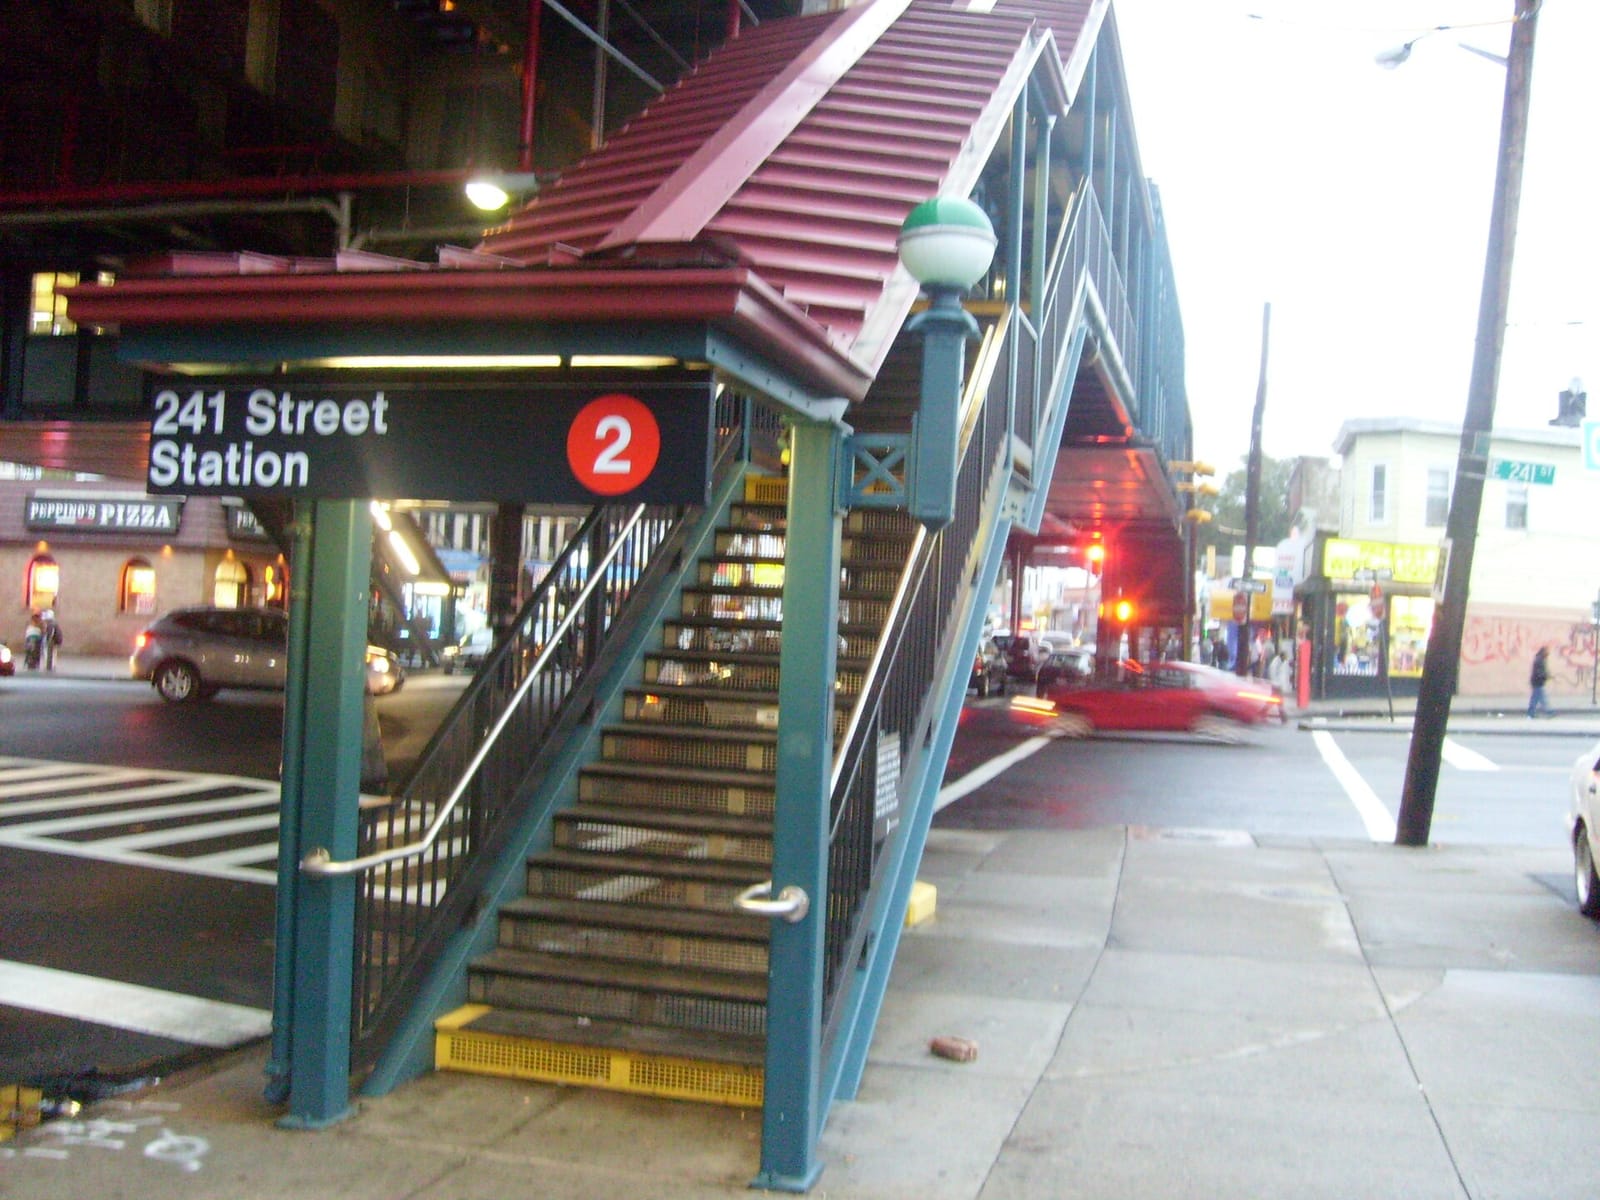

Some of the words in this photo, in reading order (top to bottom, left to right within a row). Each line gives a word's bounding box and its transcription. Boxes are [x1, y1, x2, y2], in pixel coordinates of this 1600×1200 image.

[152, 389, 226, 436] 241
[245, 388, 389, 436] Street
[149, 440, 310, 488] Station
[593, 414, 632, 475] 2
[1508, 461, 1535, 483] 241
[99, 503, 172, 529] PIZZA
